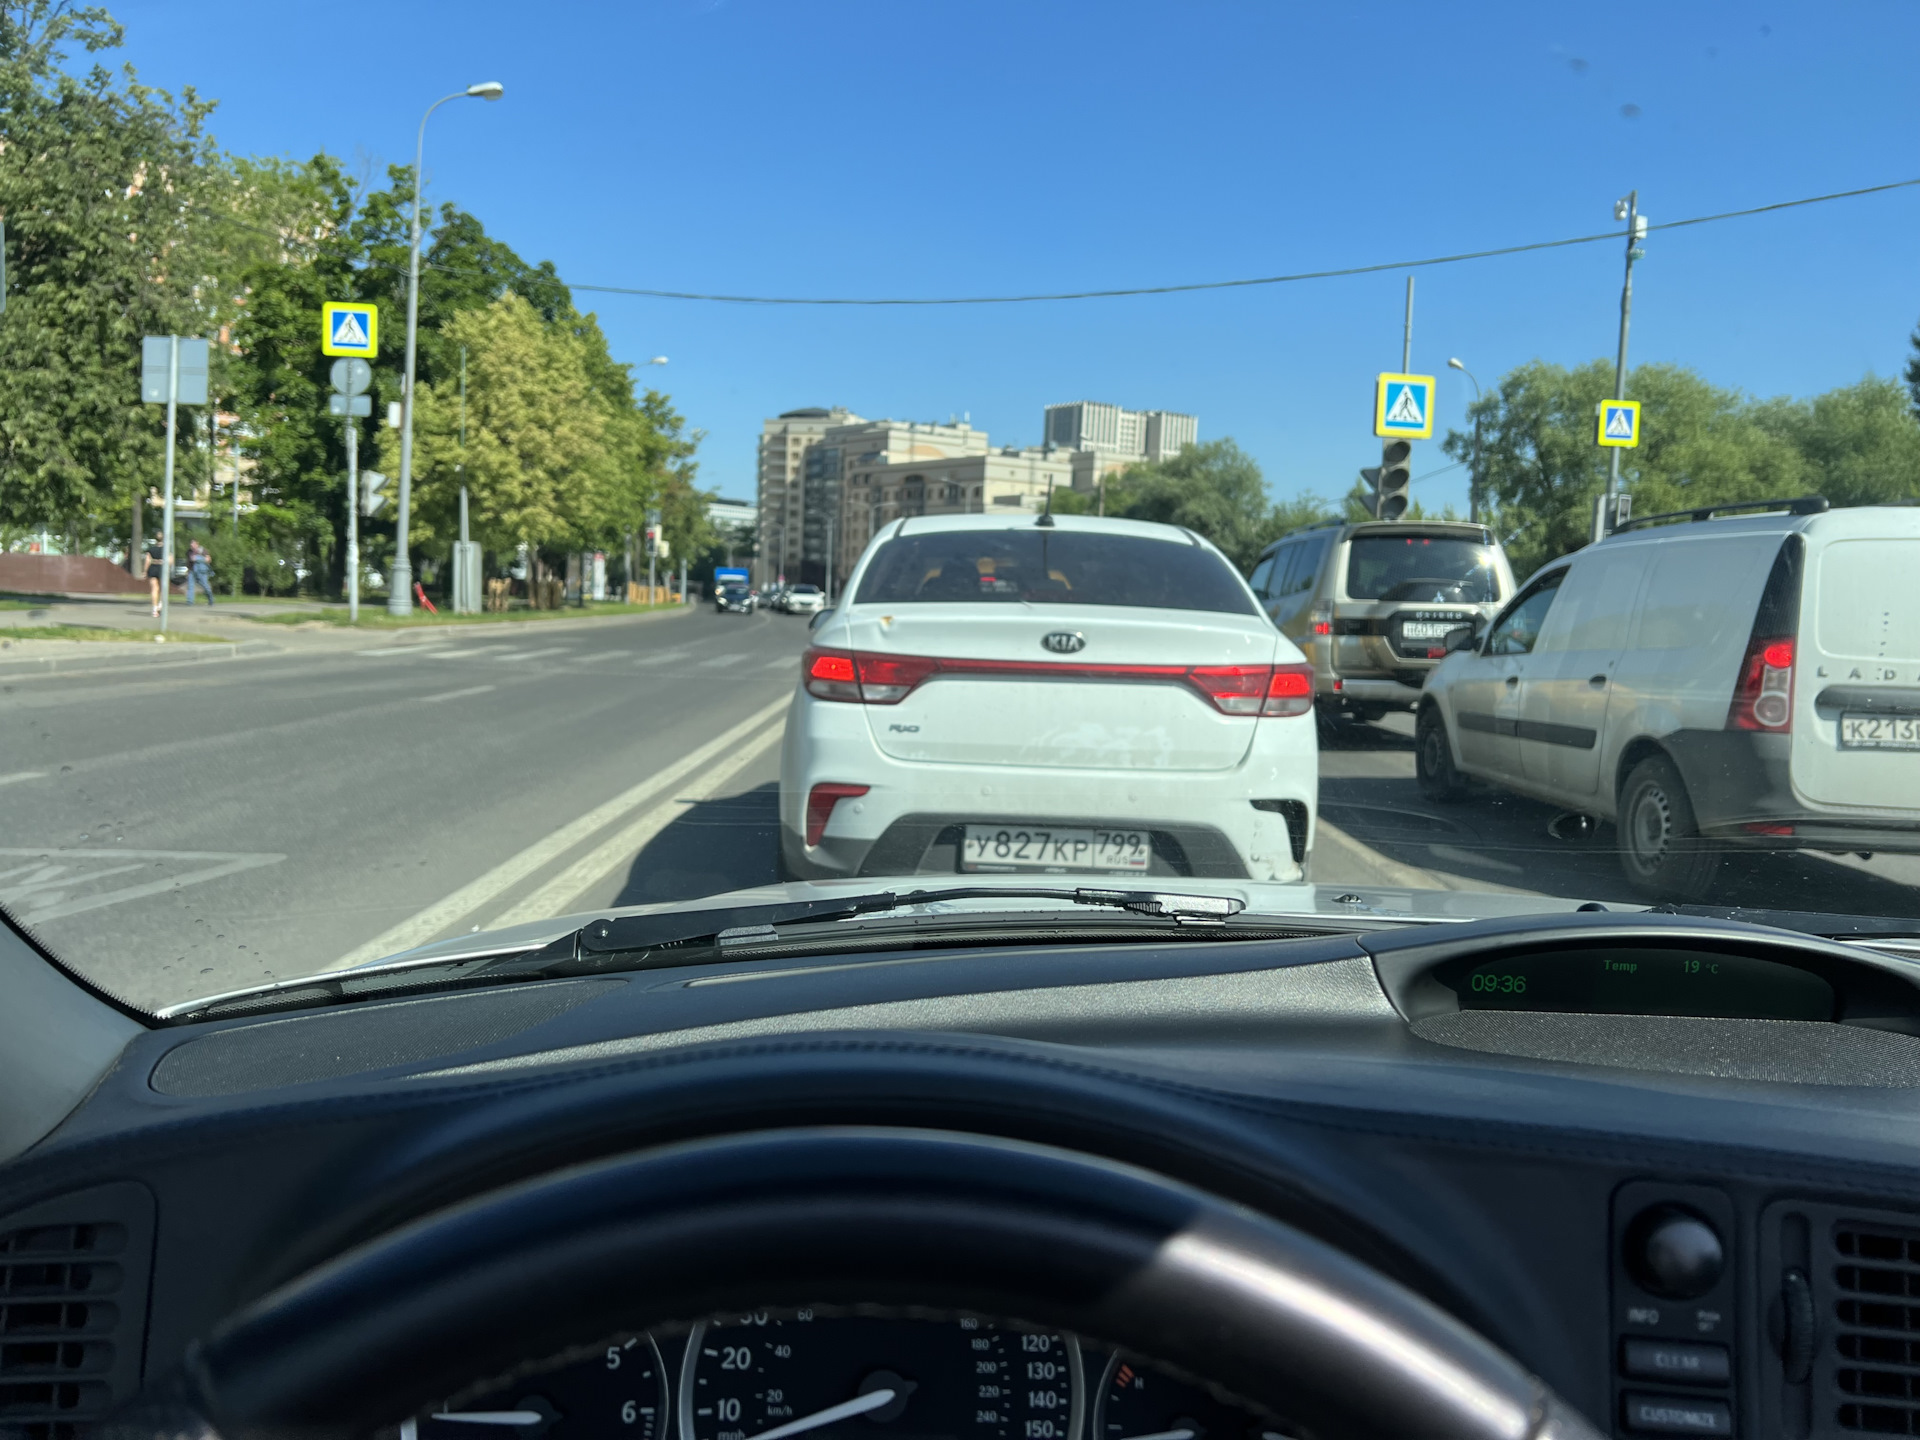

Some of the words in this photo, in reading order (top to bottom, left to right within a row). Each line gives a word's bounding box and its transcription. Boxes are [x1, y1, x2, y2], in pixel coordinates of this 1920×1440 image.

[1047, 635, 1080, 651] KIA
[1816, 665, 1920, 682] LAD
[1851, 717, 1920, 740] К213
[1603, 959, 1638, 973] Temp
[1683, 960, 1700, 974] 19
[1471, 974, 1526, 993] 09:36
[960, 1318, 978, 1330] 160
[774, 1344, 791, 1359] 40
[971, 1338, 990, 1351] 180
[1021, 1334, 1050, 1353] 120
[606, 1347, 621, 1370] 5
[720, 1346, 752, 1370] 20
[976, 1361, 997, 1374] 200
[1027, 1362, 1056, 1380] 130
[766, 1388, 783, 1403] 20
[978, 1385, 999, 1398] 220
[1028, 1390, 1057, 1409] 140
[622, 1400, 636, 1424] 6
[717, 1397, 741, 1422] 10
[767, 1405, 793, 1417] km/h
[976, 1410, 998, 1423] 240
[1025, 1420, 1054, 1438] 150
